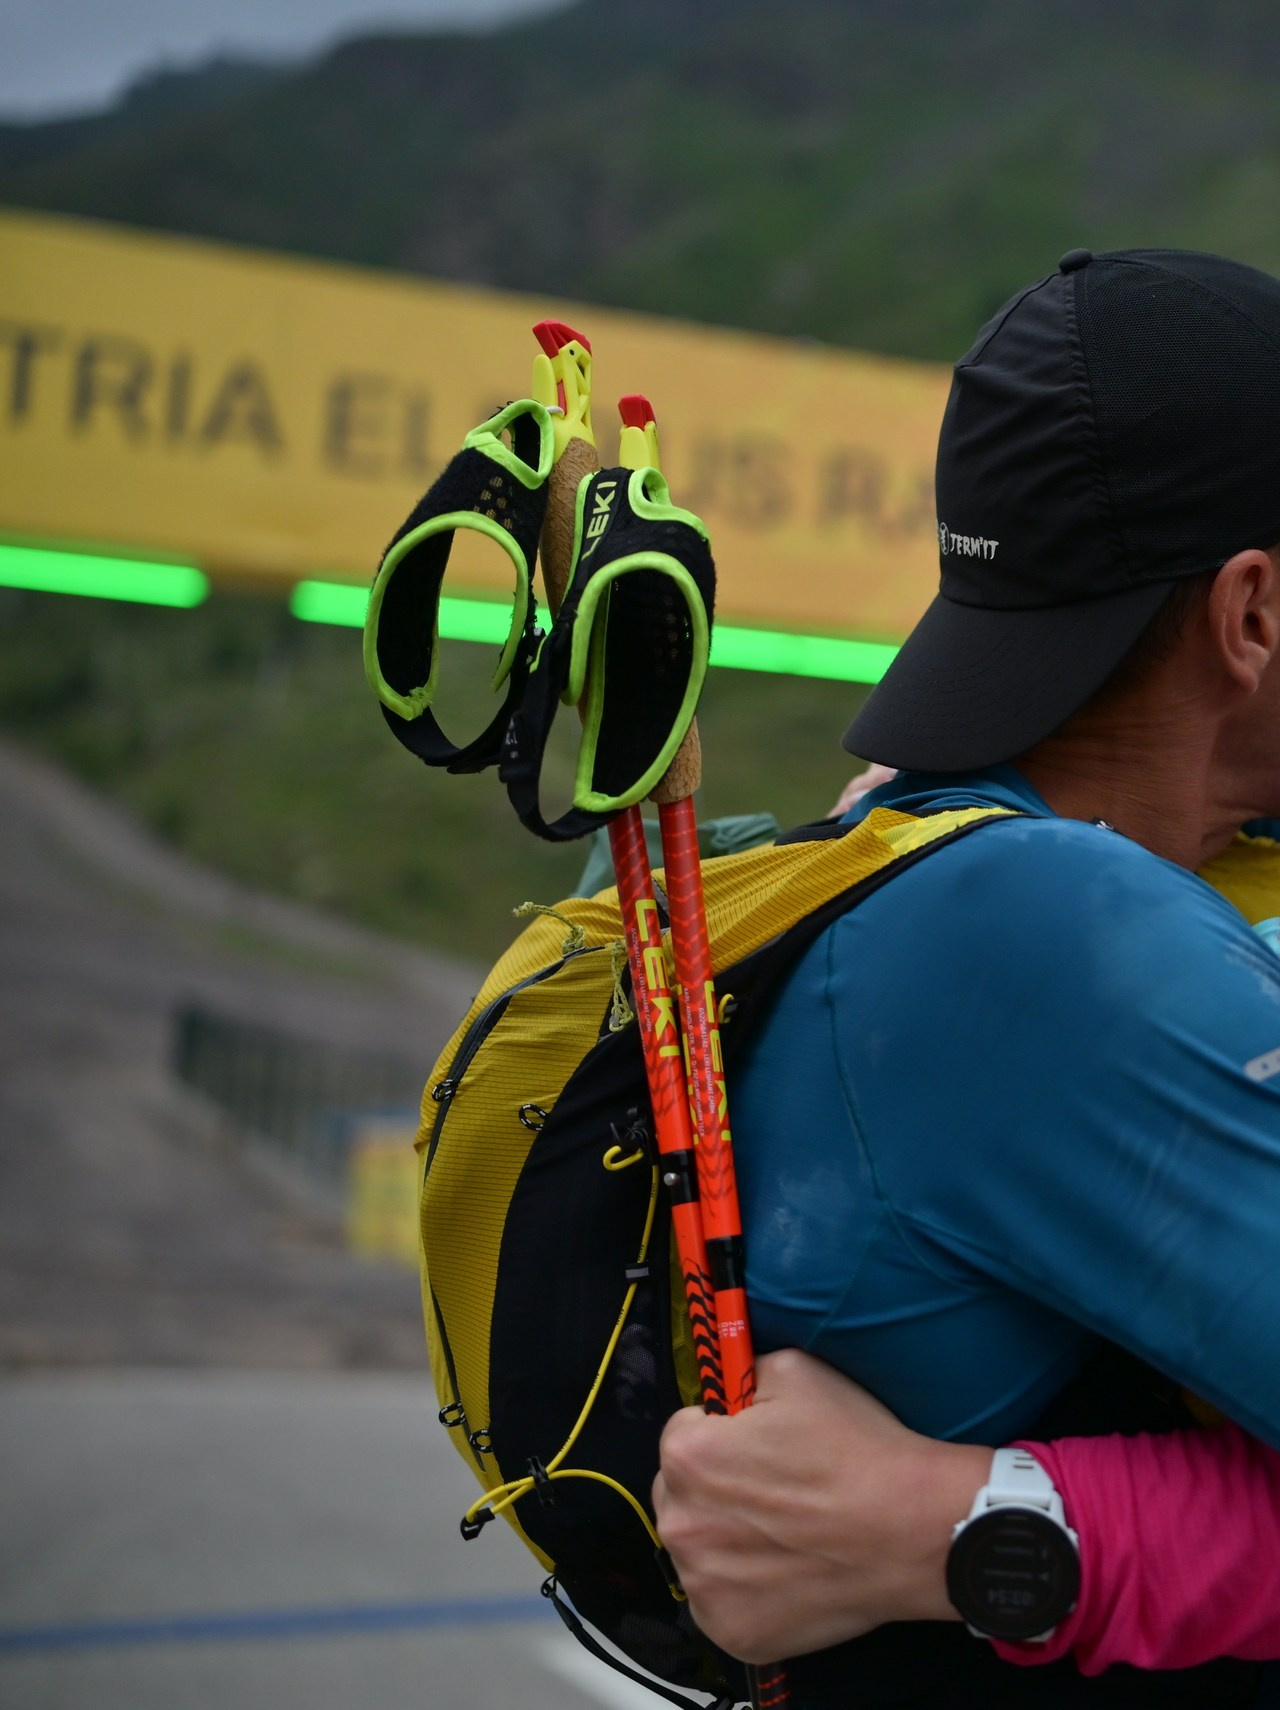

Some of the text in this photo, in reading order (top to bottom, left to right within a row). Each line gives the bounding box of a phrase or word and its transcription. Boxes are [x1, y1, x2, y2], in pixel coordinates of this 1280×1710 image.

[322, 365, 795, 540] ELUS
[581, 481, 617, 561] LEKI
[635, 899, 681, 1057] LEKI
